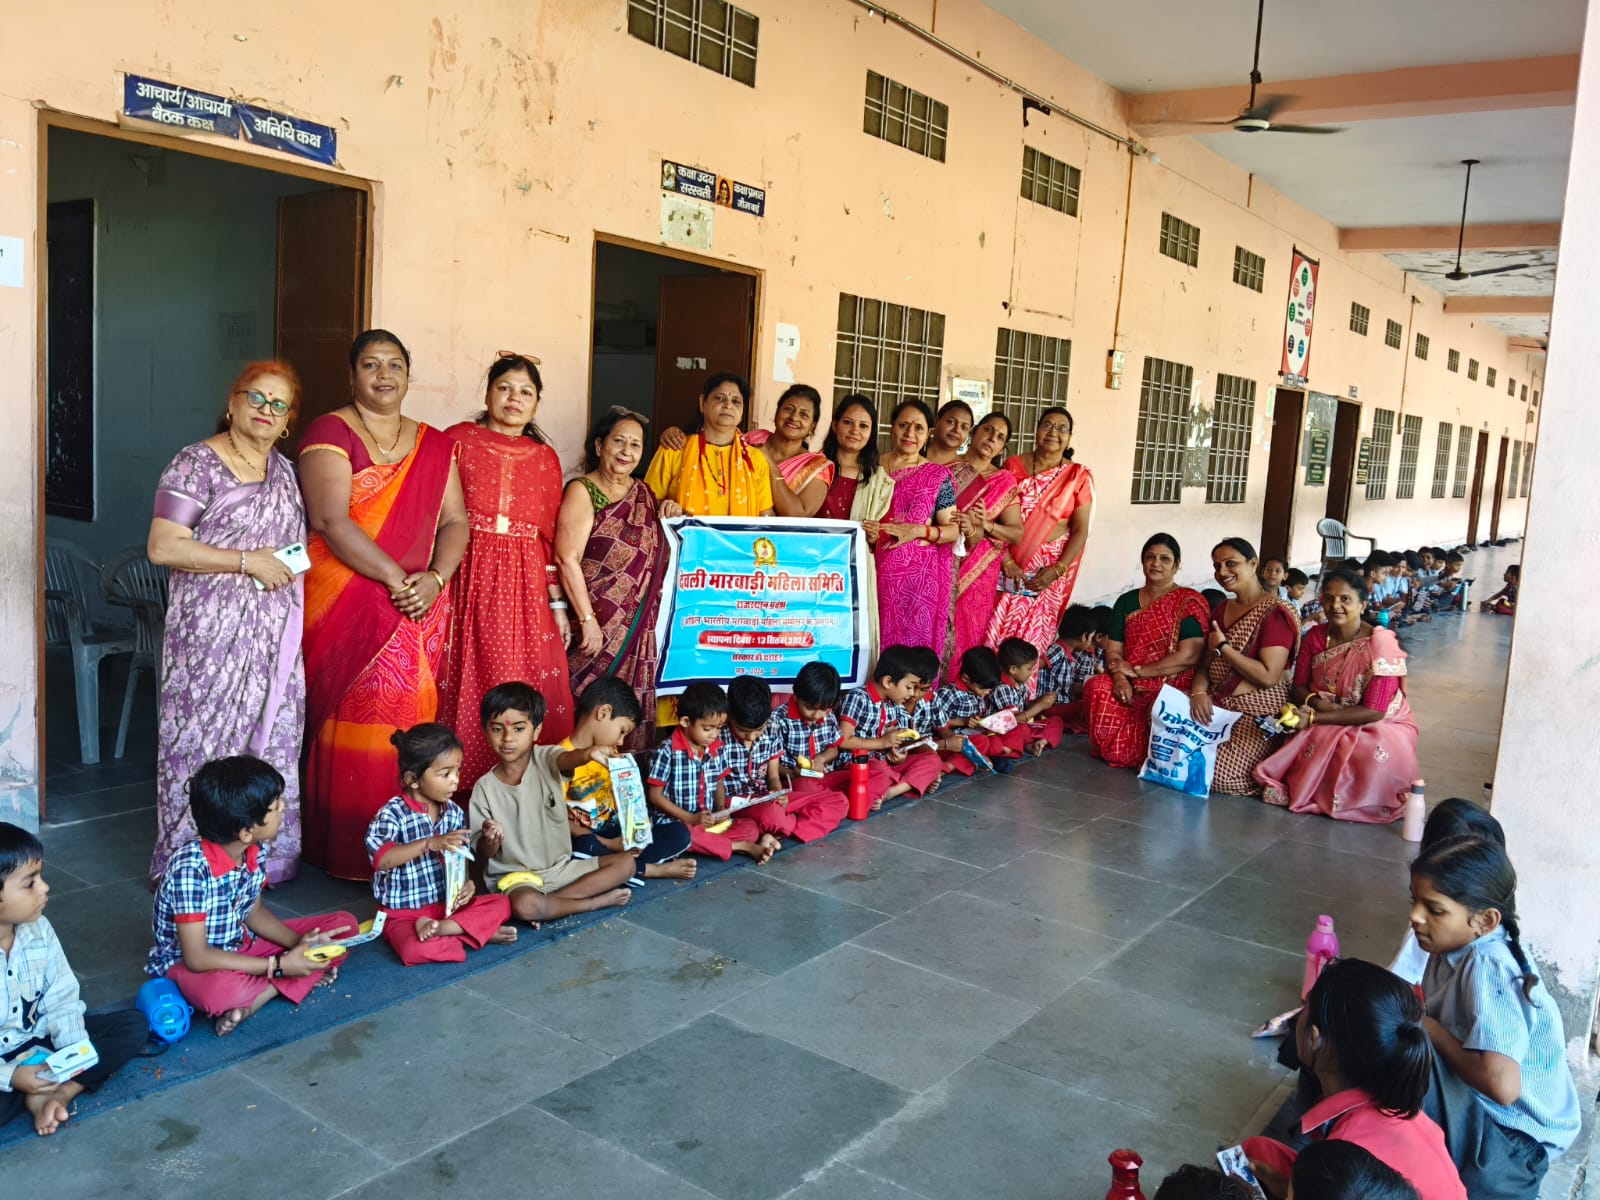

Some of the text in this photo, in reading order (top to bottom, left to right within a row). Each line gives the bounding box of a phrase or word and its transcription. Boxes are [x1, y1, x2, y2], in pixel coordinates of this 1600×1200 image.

[136, 81, 232, 118] आचार्य/आचार्या
[151, 103, 214, 132] बैठक कक्ष
[253, 117, 322, 148] अतिथि कक्ष
[678, 166, 715, 186] कक्षा उदय
[680, 182, 712, 199] सरस्वती
[709, 571, 766, 595] मारवाड़ी
[768, 572, 807, 591] महिला
[808, 573, 844, 592] समिति
